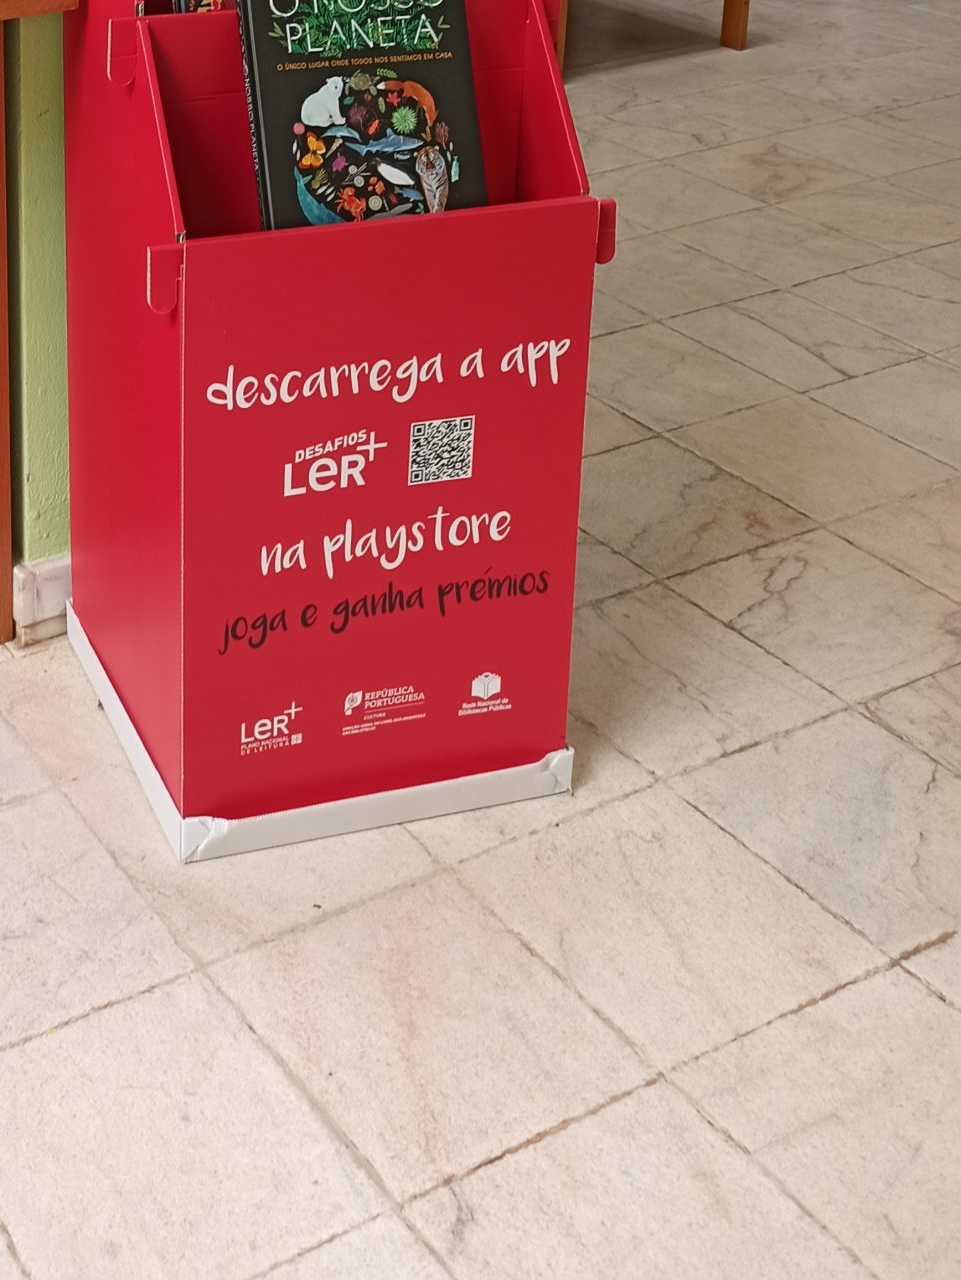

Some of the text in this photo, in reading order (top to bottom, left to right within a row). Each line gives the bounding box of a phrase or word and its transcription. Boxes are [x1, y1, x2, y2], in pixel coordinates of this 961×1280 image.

[285, 13, 439, 54] PLANETA
[285, 61, 307, 70] ÚNICO
[308, 60, 329, 69] LUGAR
[331, 58, 349, 68] ONDE
[351, 58, 373, 66] TODOS
[374, 56, 389, 64] NOS
[389, 54, 423, 63] SENTIMOS
[423, 53, 433, 61] EM
[435, 52, 453, 60] CASA
[206, 338, 571, 410] descarrega a app
[295, 429, 367, 463] DESAFIOS
[259, 506, 512, 580] na playstore
[218, 568, 550, 656] joga e ganha prémios
[365, 685, 415, 701] REPÚBLICA
[365, 692, 426, 709] PORTUGUESA
